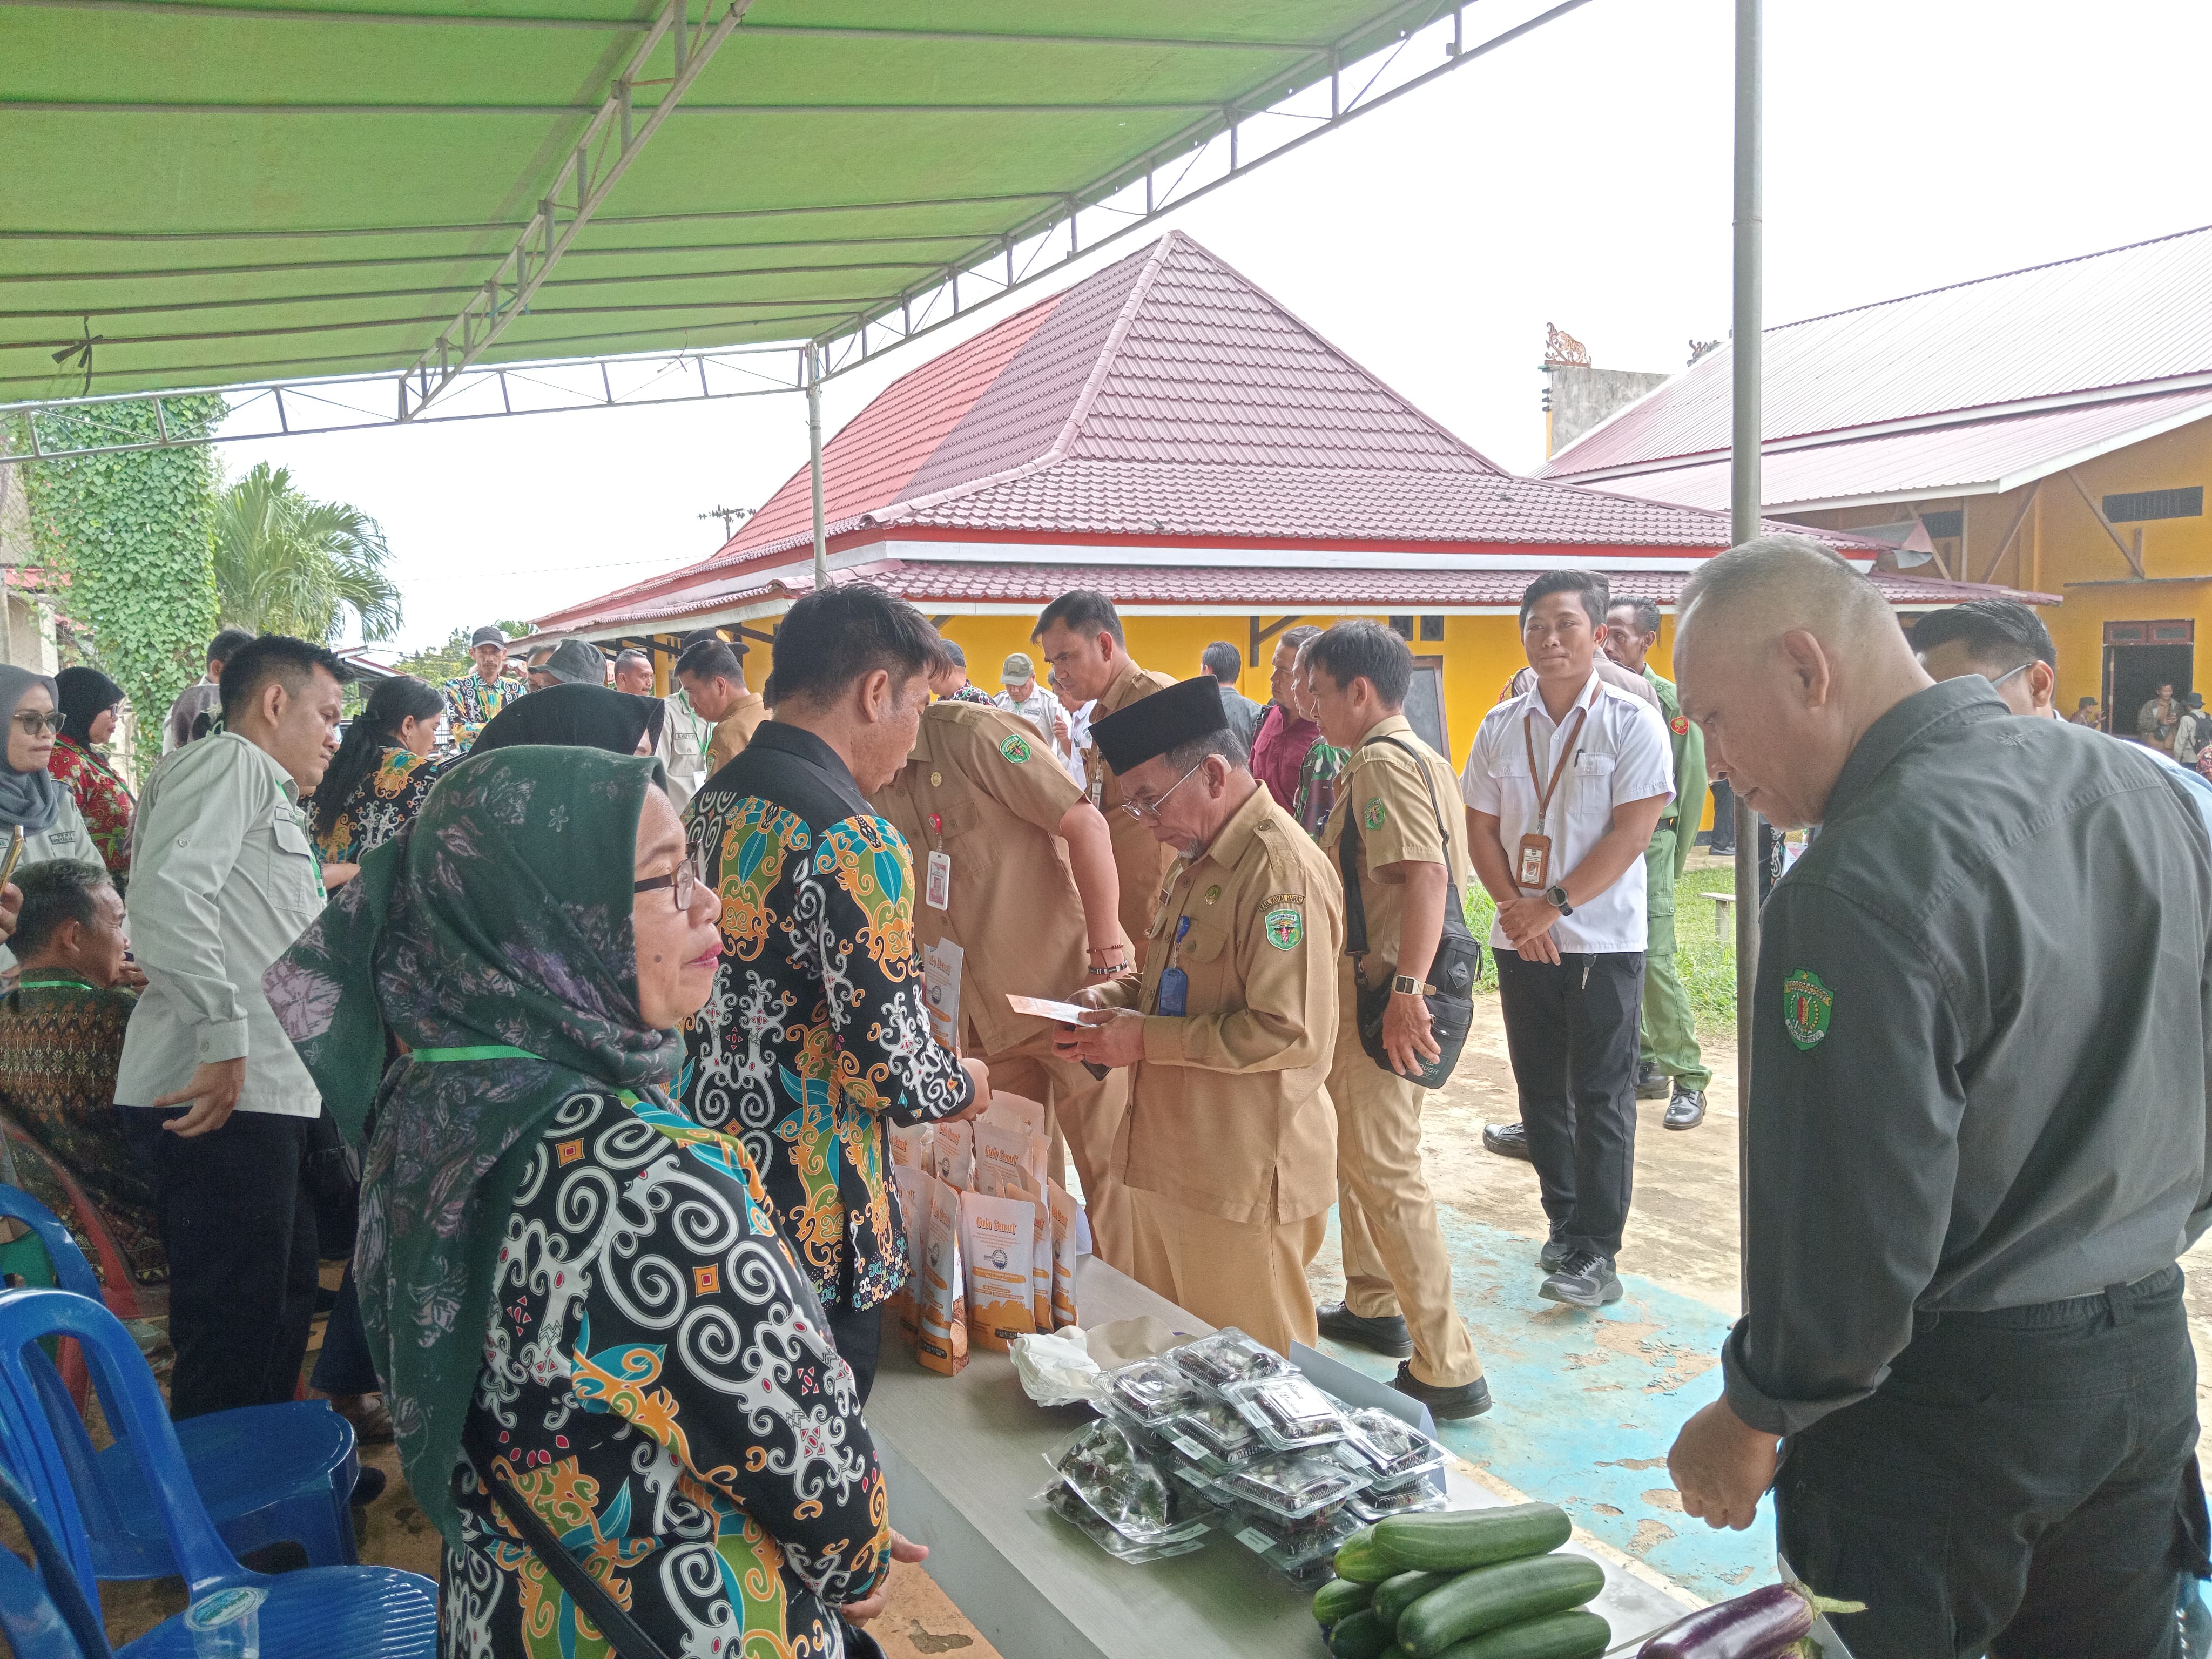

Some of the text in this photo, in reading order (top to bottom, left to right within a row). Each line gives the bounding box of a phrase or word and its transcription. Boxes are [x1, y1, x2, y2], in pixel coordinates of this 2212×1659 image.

[1259, 901, 1271, 911] KAB.
[1271, 895, 1285, 903] KUTAI
[1419, 1064, 1439, 1074] OUGH
[985, 1144, 1018, 1166] Gula Semut
[976, 1216, 1017, 1235] Gula Semut
[1034, 1218, 1044, 1231] mut
